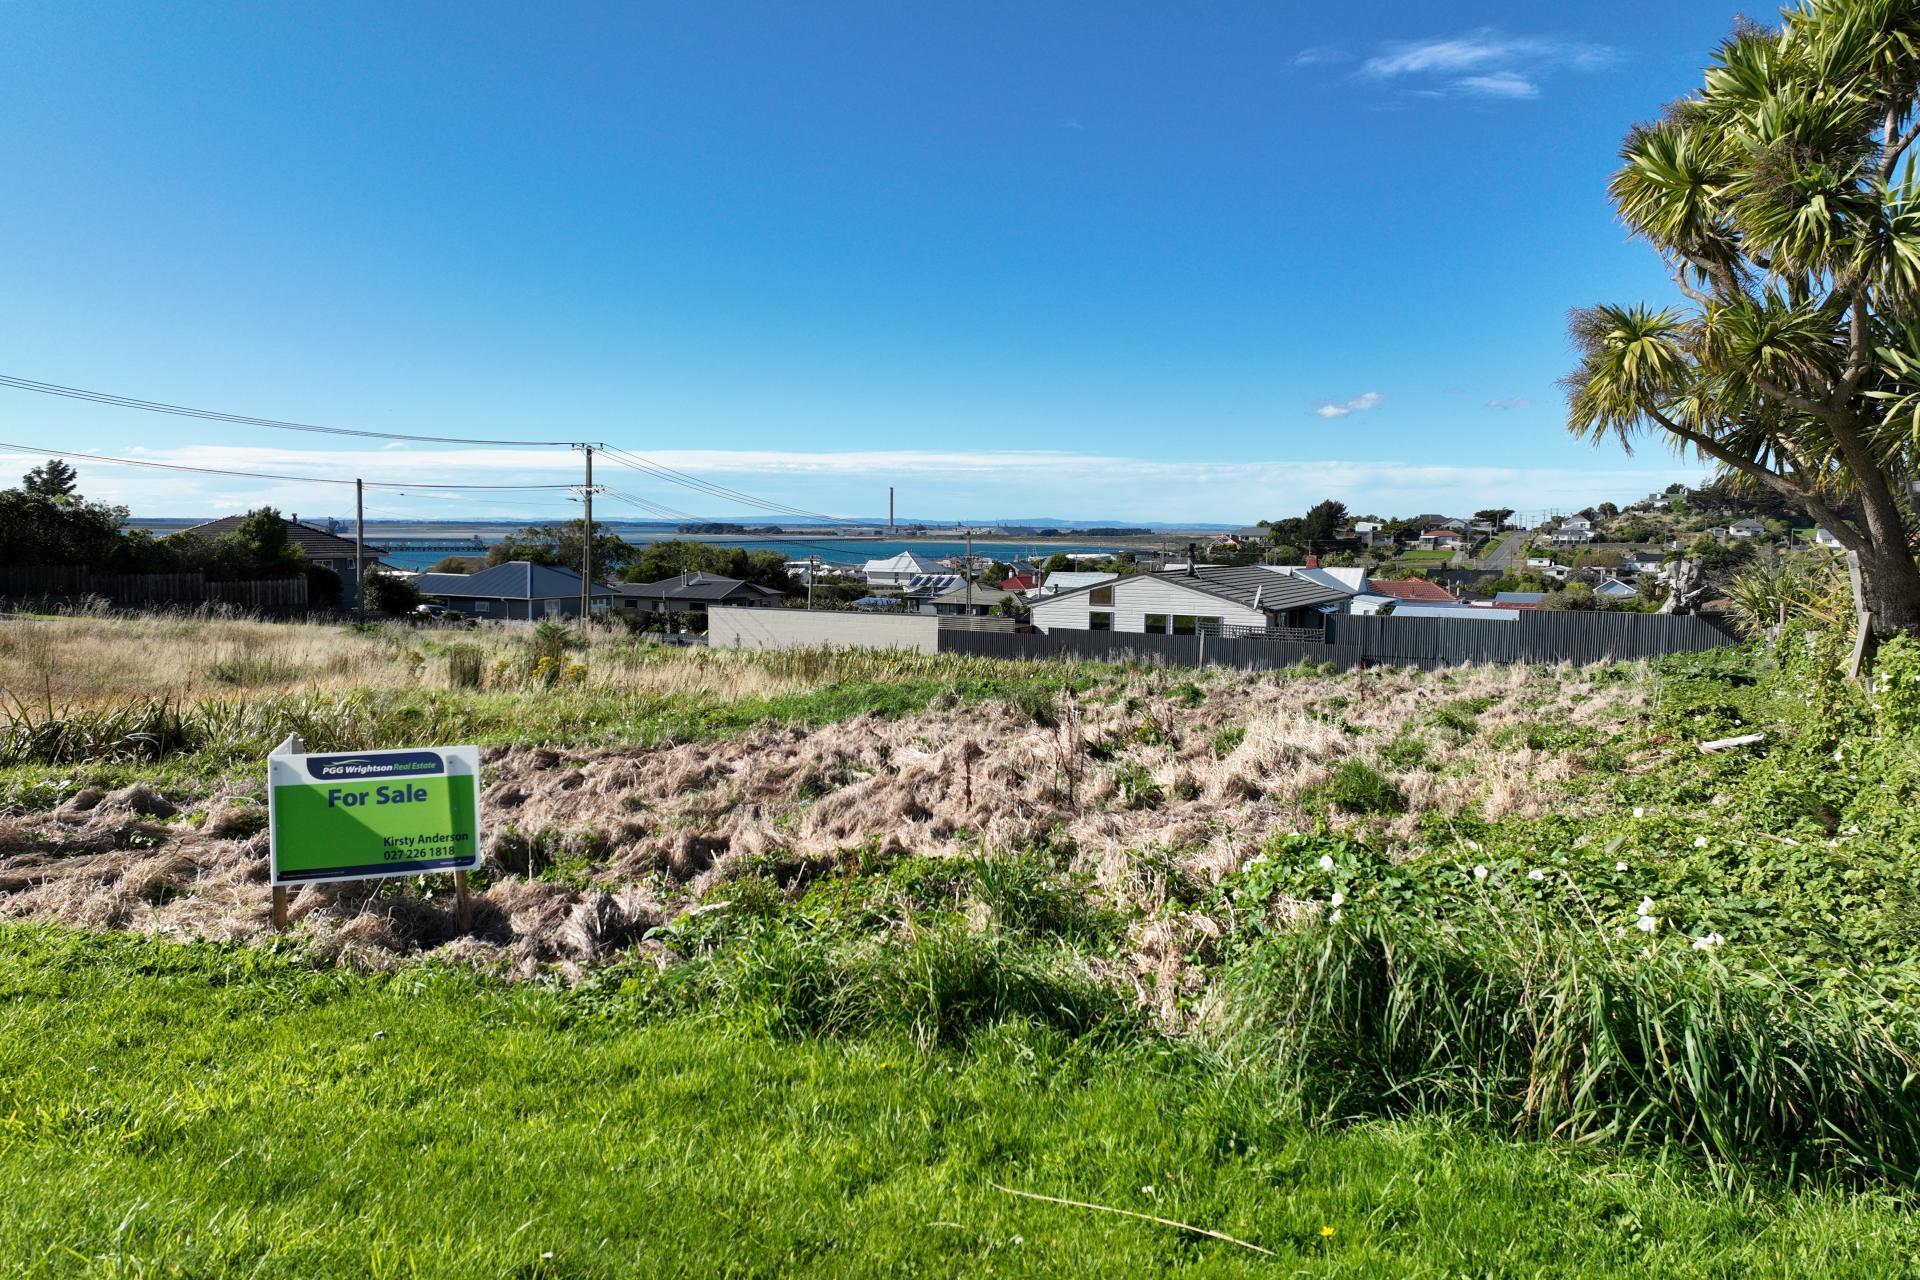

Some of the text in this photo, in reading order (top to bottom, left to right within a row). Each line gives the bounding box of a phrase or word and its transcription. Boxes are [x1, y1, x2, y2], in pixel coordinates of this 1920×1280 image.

[322, 762, 436, 775] PGG Wrightson Real Estate
[328, 784, 427, 808] For Sale
[383, 833, 468, 847] Kirsty Anderson
[383, 846, 455, 860] 027 226 1818
